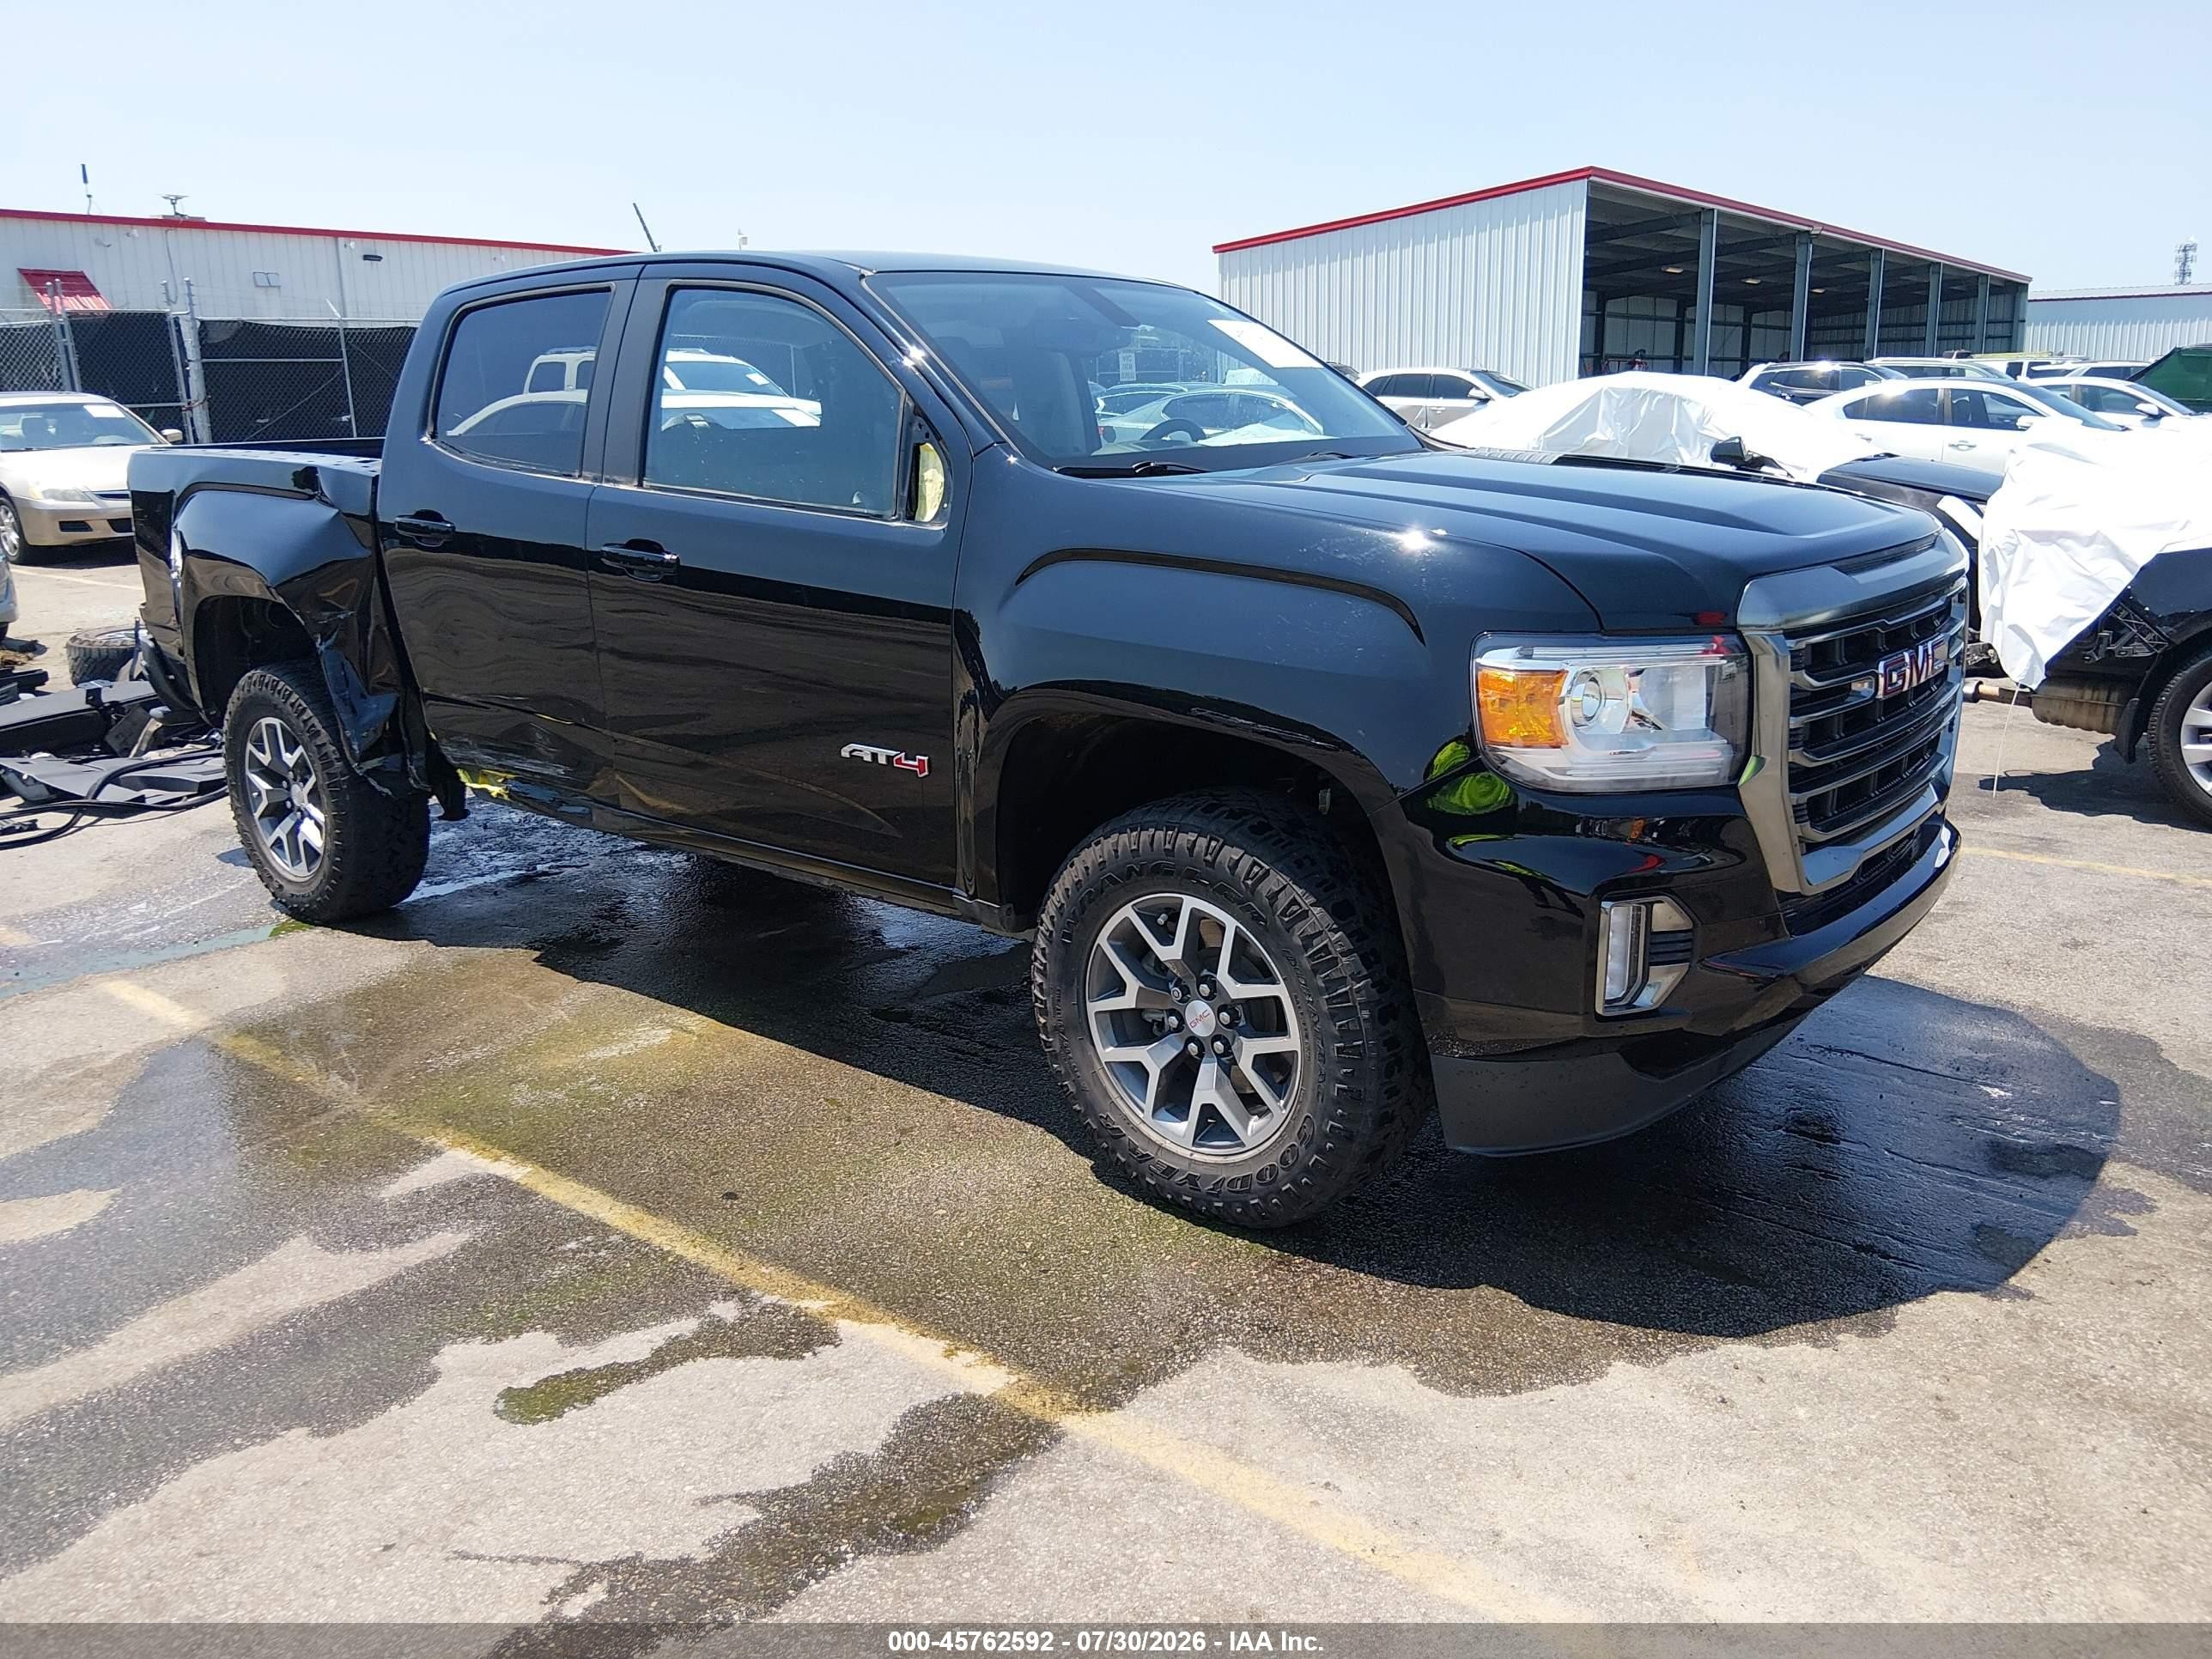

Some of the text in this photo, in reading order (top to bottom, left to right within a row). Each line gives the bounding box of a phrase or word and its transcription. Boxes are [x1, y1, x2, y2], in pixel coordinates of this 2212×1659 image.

[1875, 634, 1946, 701] GMC
[840, 743, 929, 778] AT4
[1189, 1009, 1211, 1029] GMC
[1098, 1113, 1315, 1194] GOODYEAR
